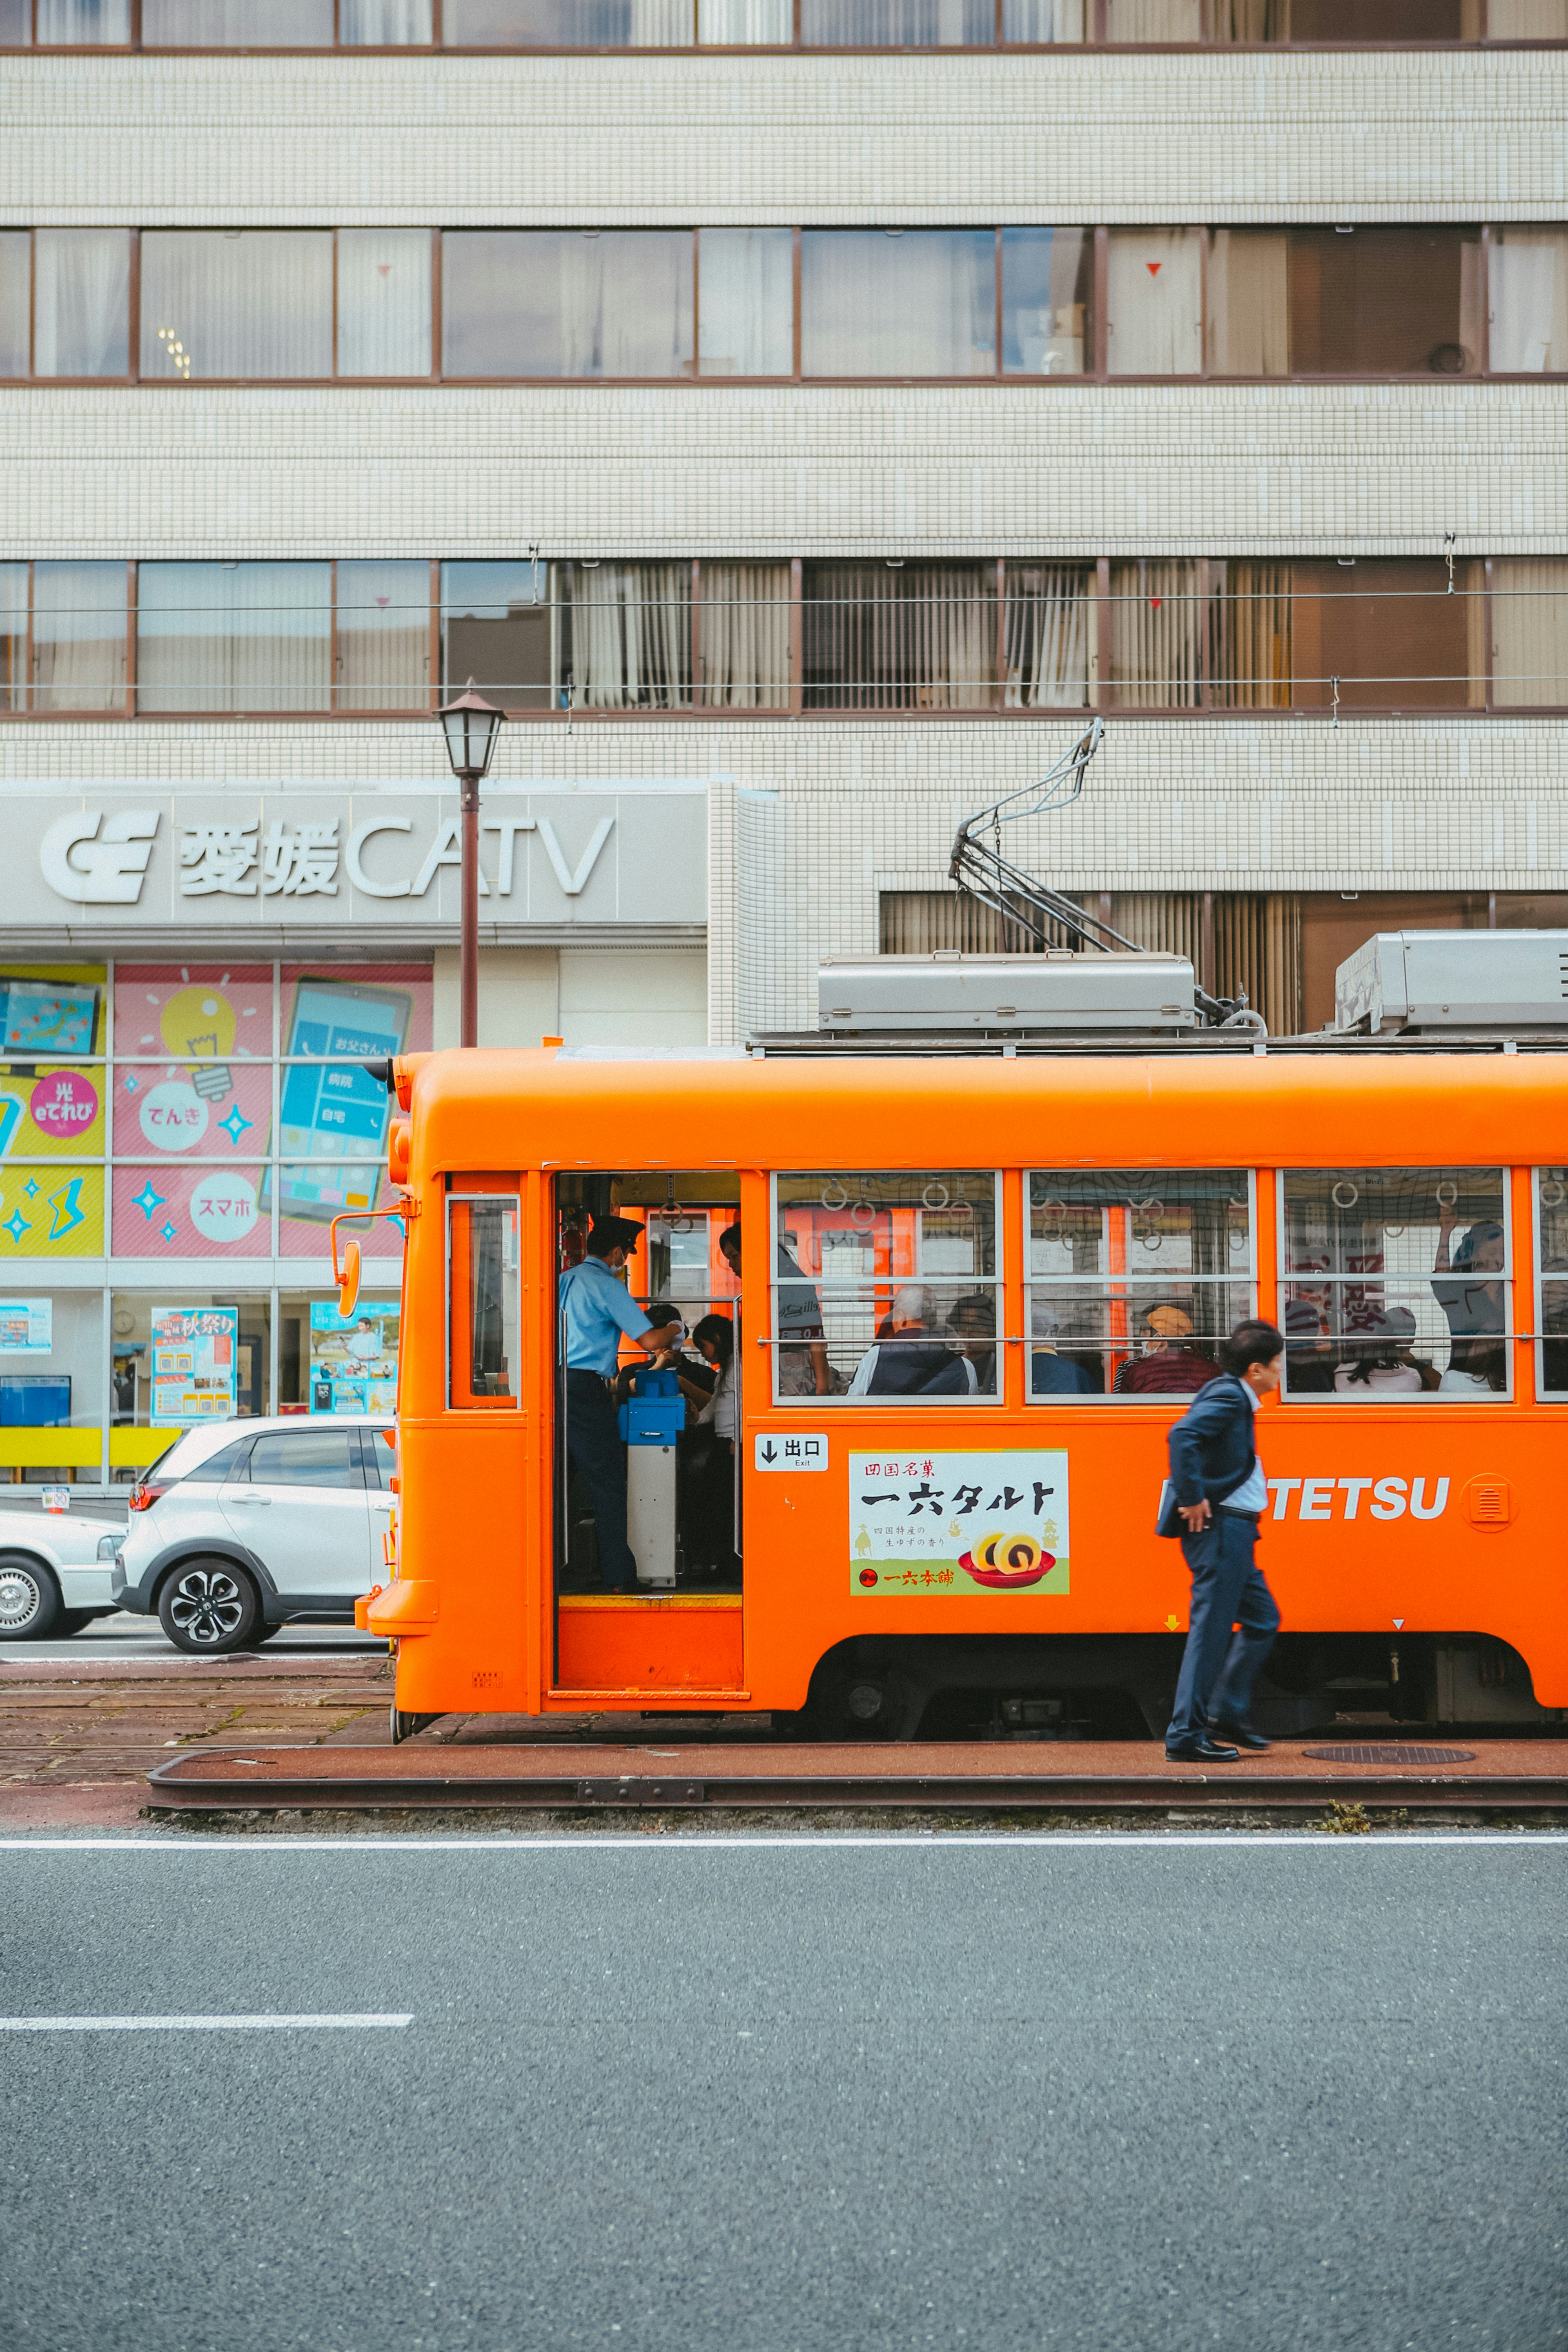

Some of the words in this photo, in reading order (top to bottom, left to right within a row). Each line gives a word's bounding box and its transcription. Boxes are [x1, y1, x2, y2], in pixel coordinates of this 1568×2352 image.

[181, 817, 615, 898] 愛媛CATV
[329, 1073, 353, 1089] 病院
[56, 1082, 73, 1102] 光
[35, 1102, 93, 1122] eてれび
[148, 1107, 200, 1125] てんき
[322, 1108, 345, 1123] 自宅
[199, 1198, 250, 1216] スマホ
[786, 1439, 819, 1457] 出口
[865, 1459, 935, 1478] 四国名菓
[862, 1483, 1054, 1516] 一六タルト
[874, 1526, 925, 1535] 四国特産の
[885, 1537, 944, 1547] 生ゆずの香り
[883, 1568, 955, 1587] 一六本舗
